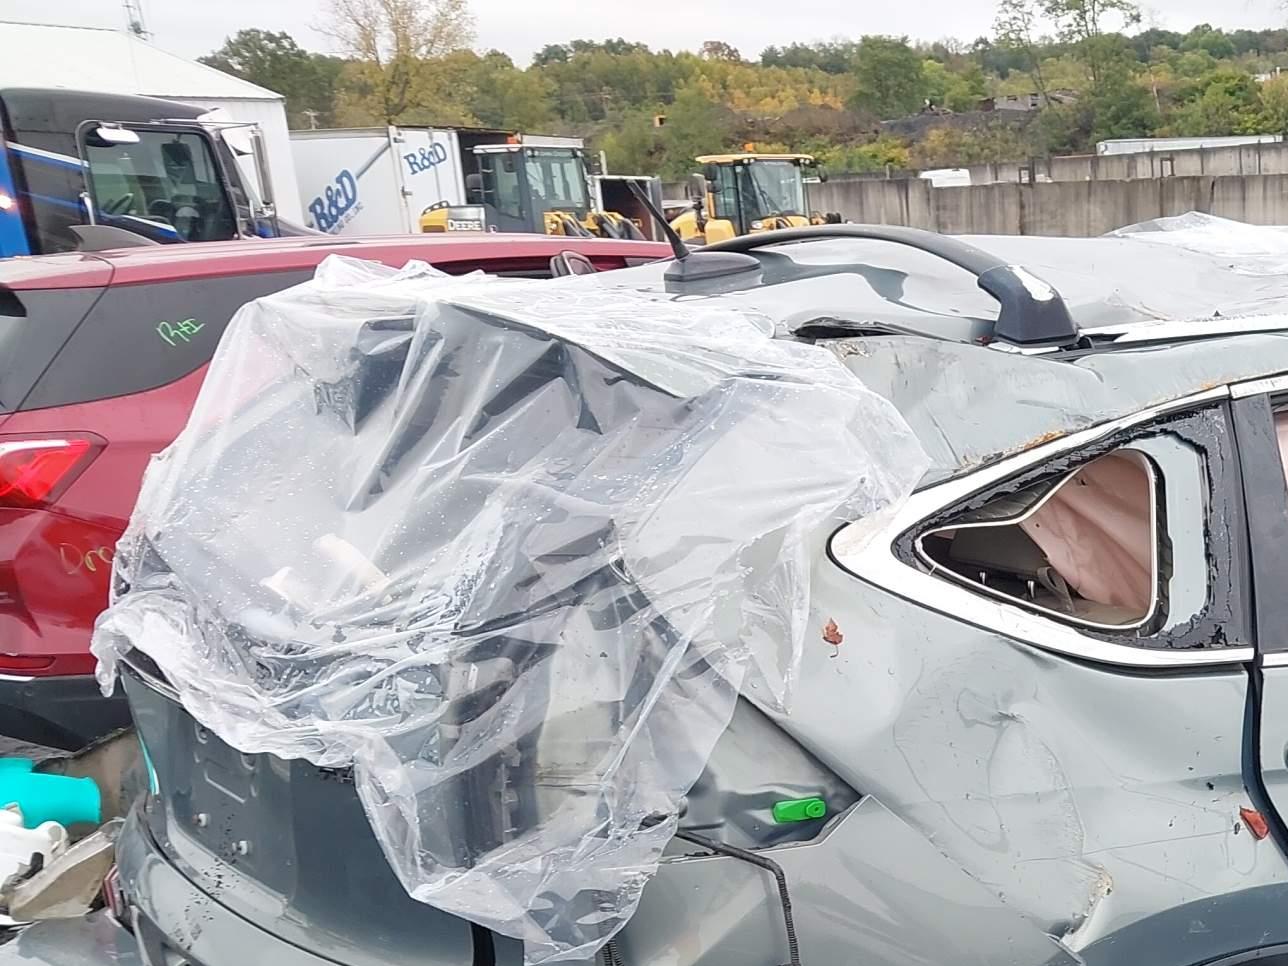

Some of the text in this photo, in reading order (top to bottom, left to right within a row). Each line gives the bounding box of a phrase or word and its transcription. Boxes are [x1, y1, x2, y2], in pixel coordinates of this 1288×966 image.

[404, 142, 448, 176] R&D
[308, 168, 358, 233] R&D
[448, 219, 482, 231] DEERE
